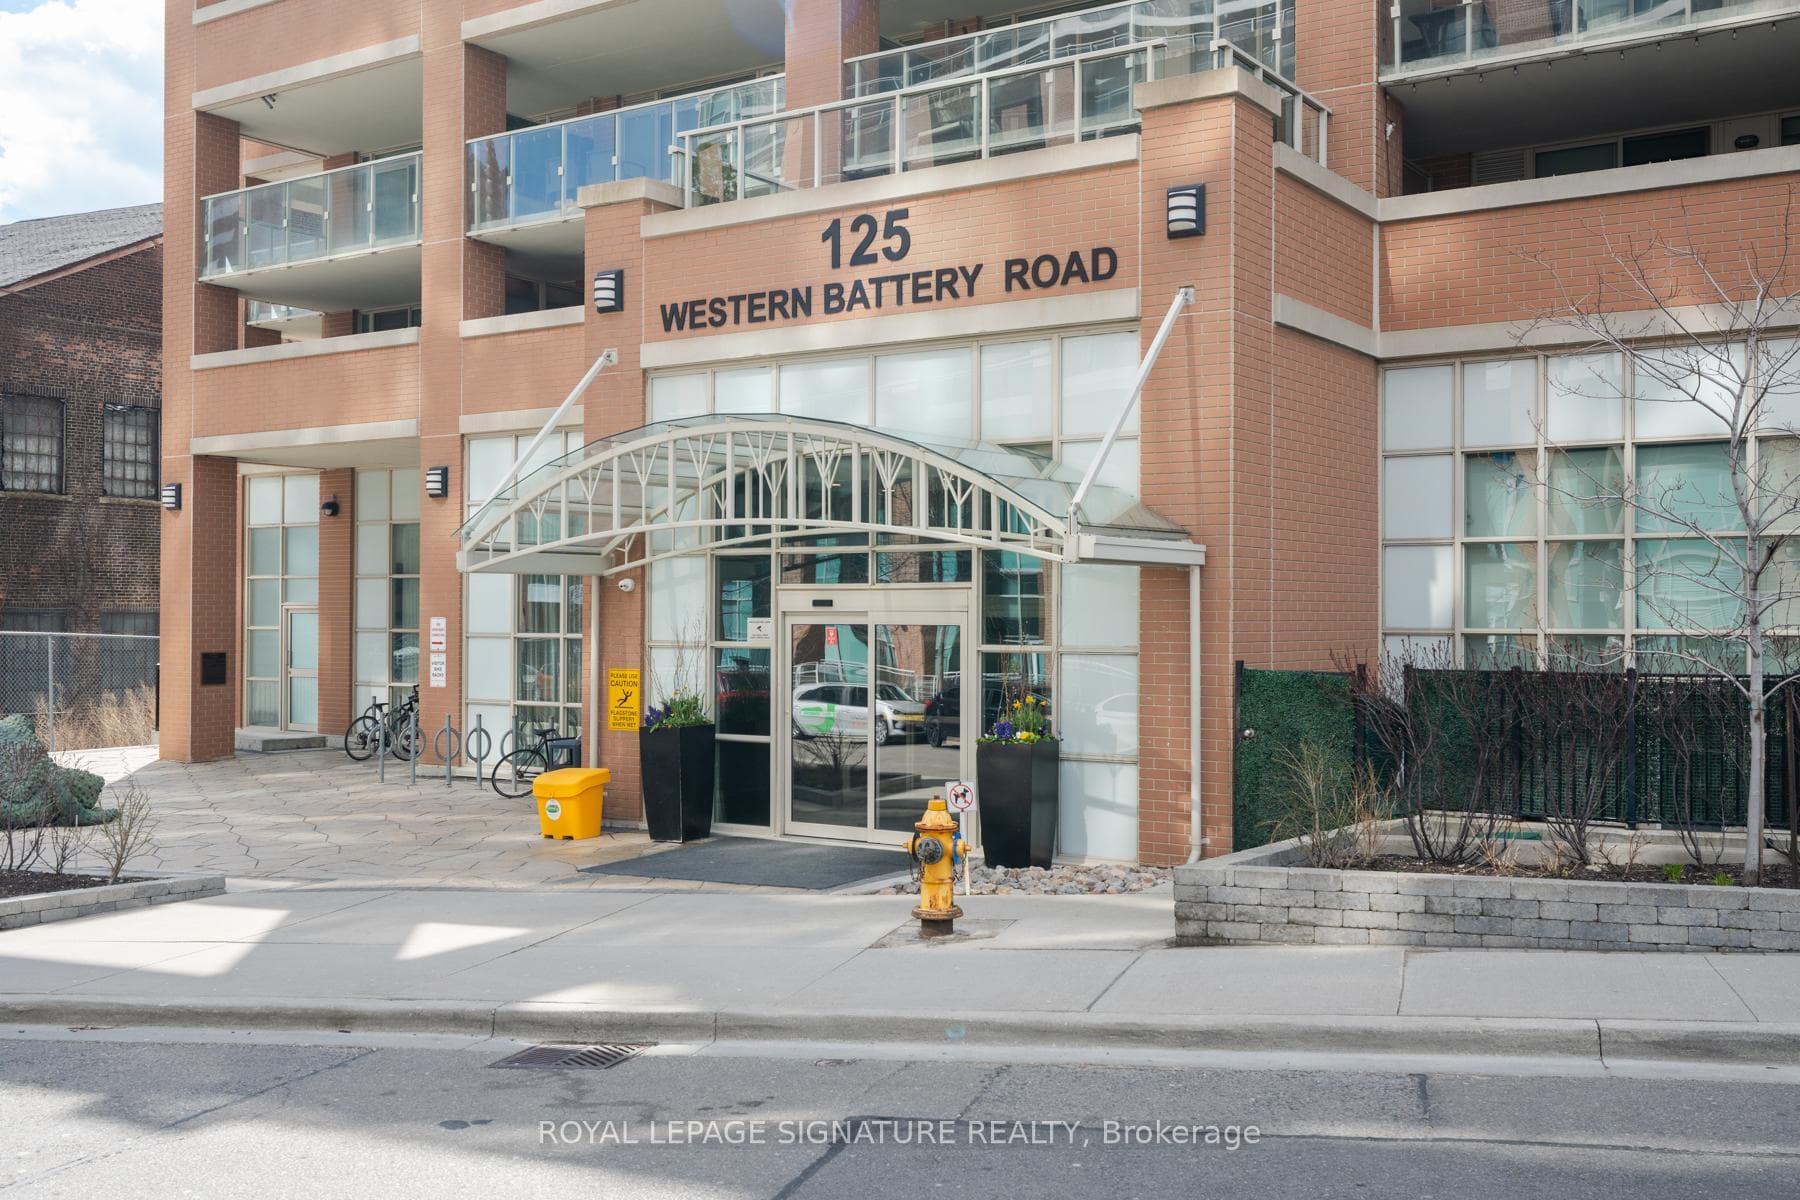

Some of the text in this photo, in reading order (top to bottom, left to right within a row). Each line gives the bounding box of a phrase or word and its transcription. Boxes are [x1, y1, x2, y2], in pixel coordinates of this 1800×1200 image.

[821, 208, 911, 269] 125
[660, 246, 1118, 333] WESTERN BATTERY ROAD
